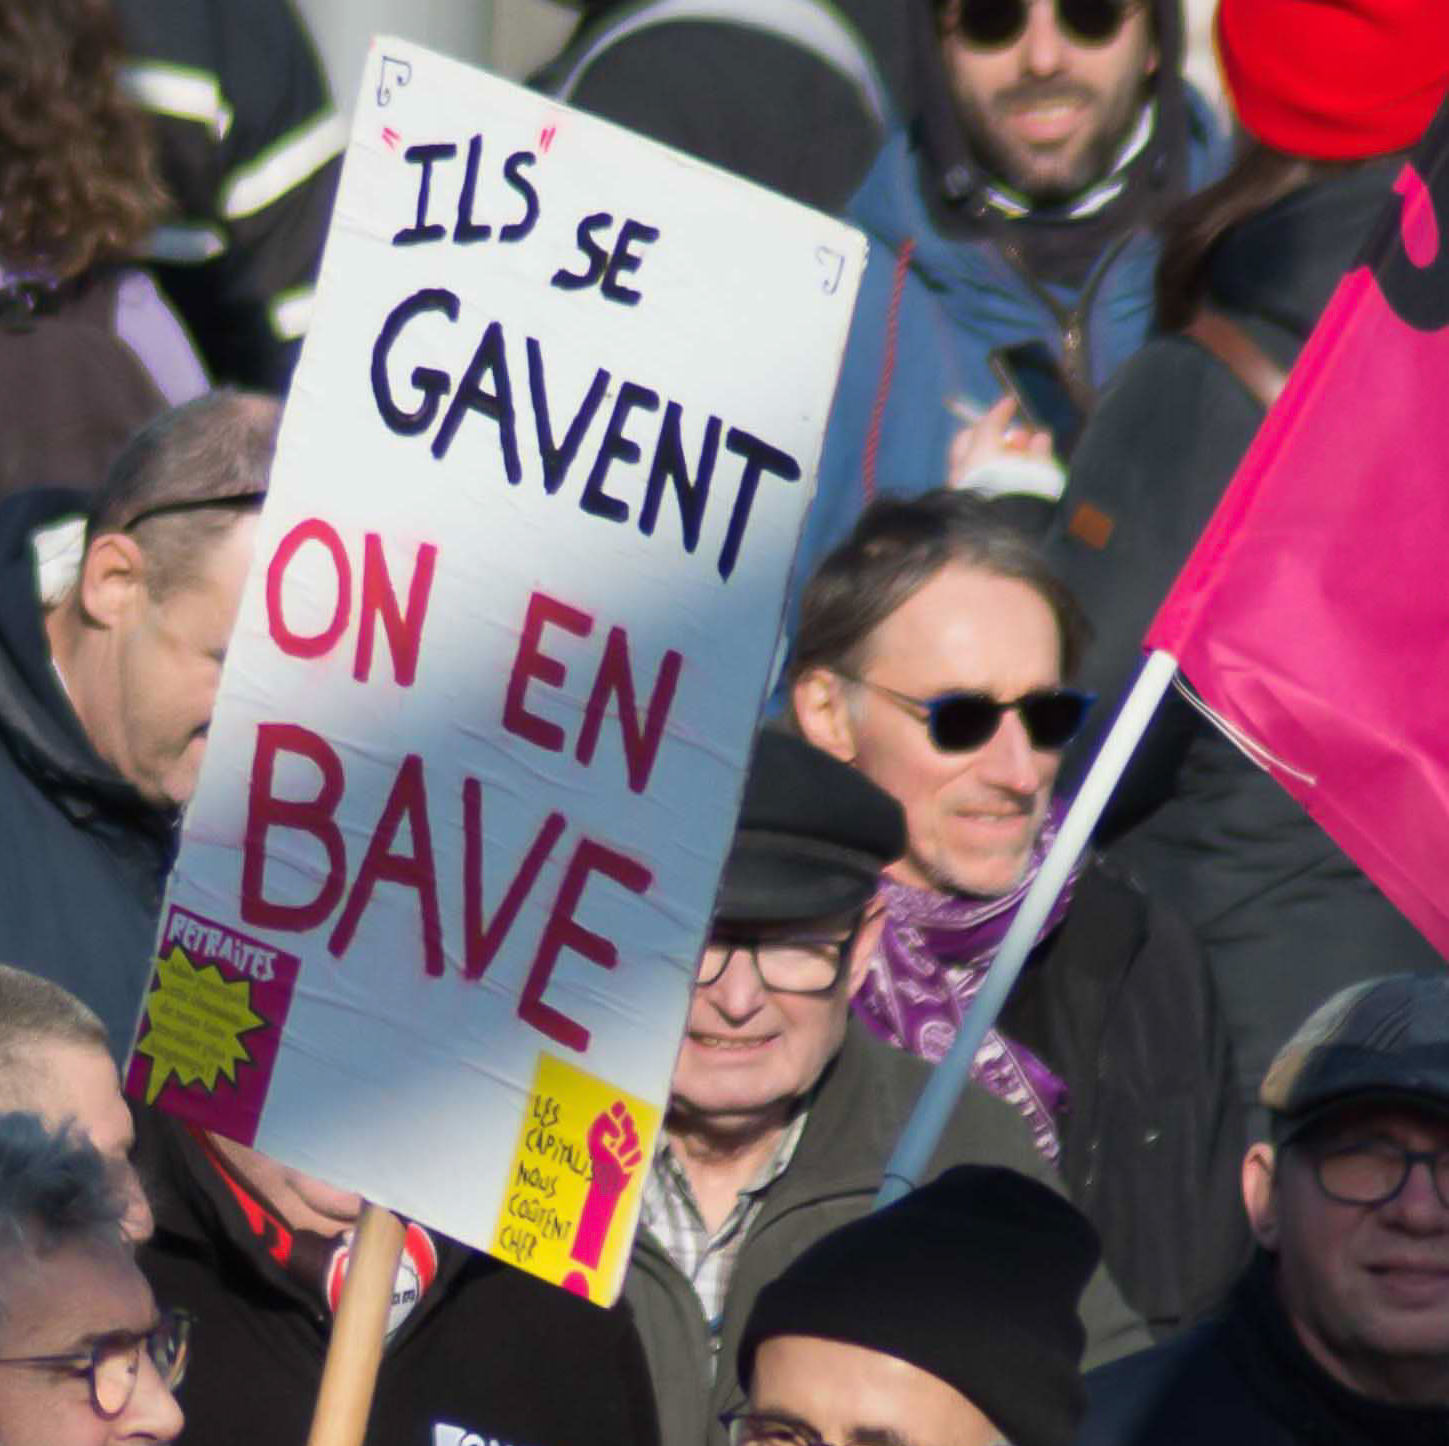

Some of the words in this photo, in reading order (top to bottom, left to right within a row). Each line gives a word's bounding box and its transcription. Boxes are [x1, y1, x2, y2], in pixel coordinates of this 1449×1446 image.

[550, 212, 661, 306] SE
[370, 287, 802, 585] GAVENT
[266, 518, 438, 688] ON
[503, 592, 684, 794] EN
[239, 722, 653, 1053] BAVE
